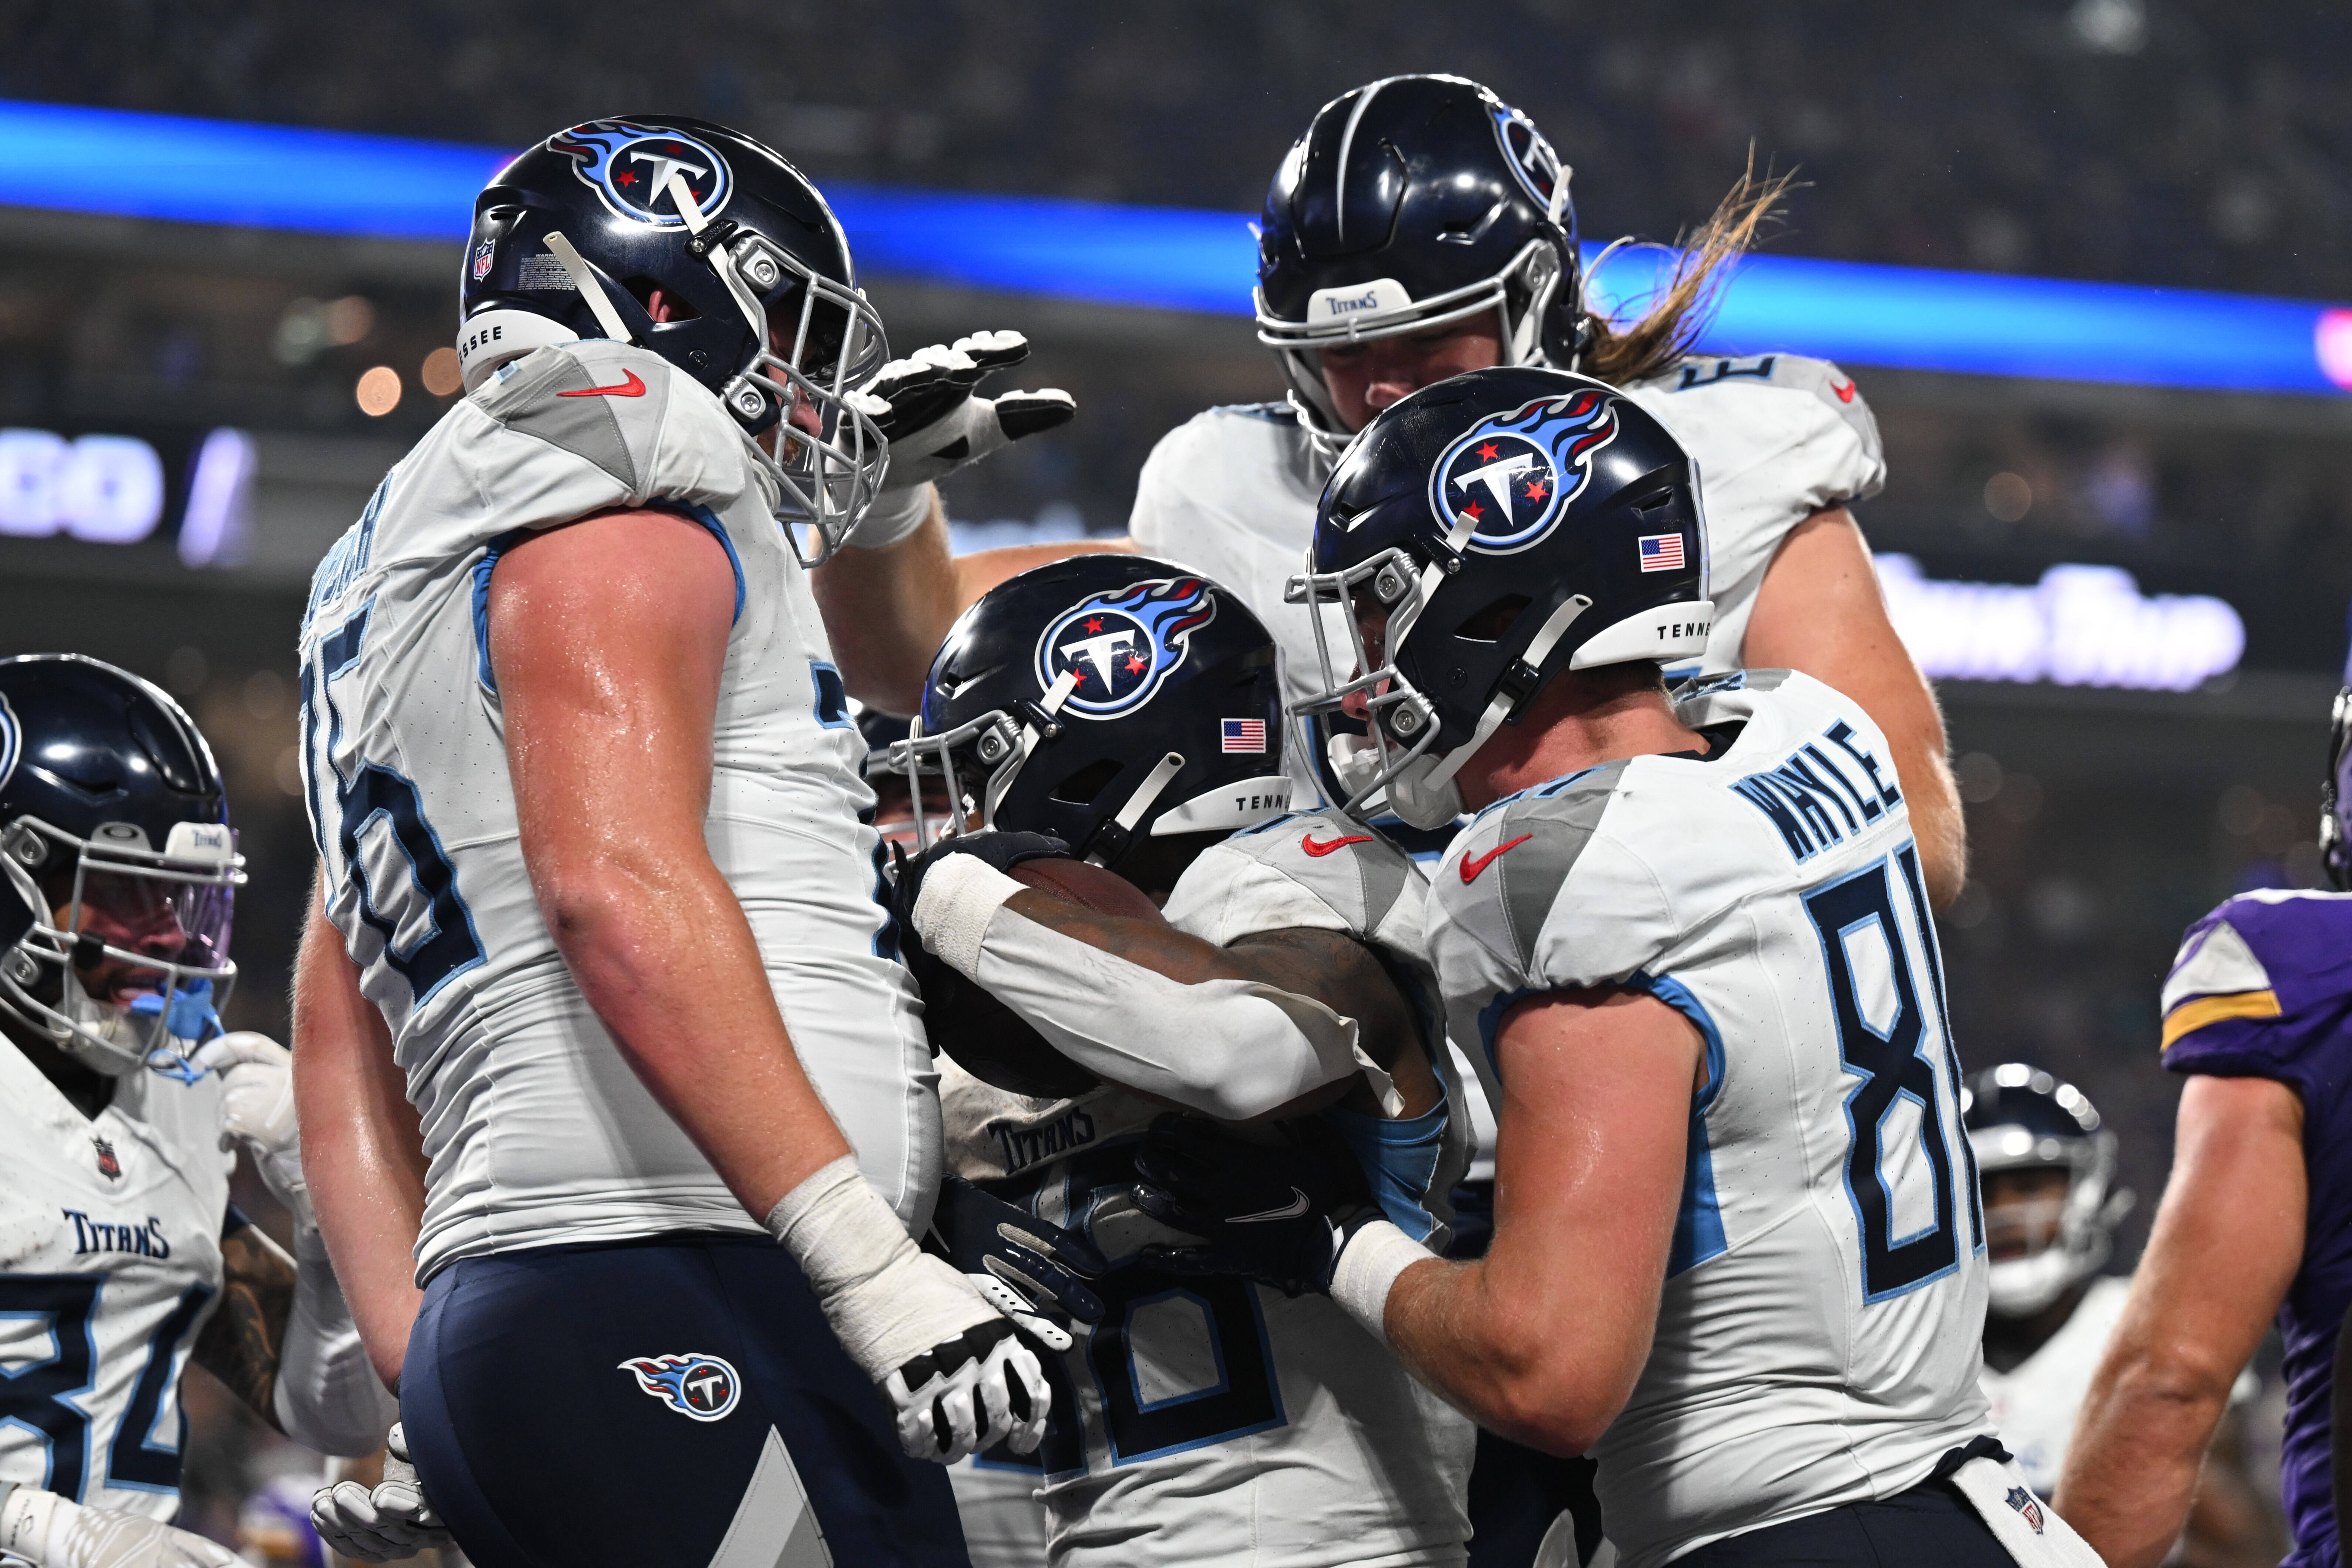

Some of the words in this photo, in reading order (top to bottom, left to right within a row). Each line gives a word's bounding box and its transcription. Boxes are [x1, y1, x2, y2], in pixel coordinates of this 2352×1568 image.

[476, 255, 490, 275] NFL
[459, 326, 501, 366] ESSEE
[1657, 622, 1710, 639] TENNE
[1800, 834, 1986, 1306] 81
[987, 1106, 1095, 1176] TITANS
[61, 1208, 170, 1259] TITANS
